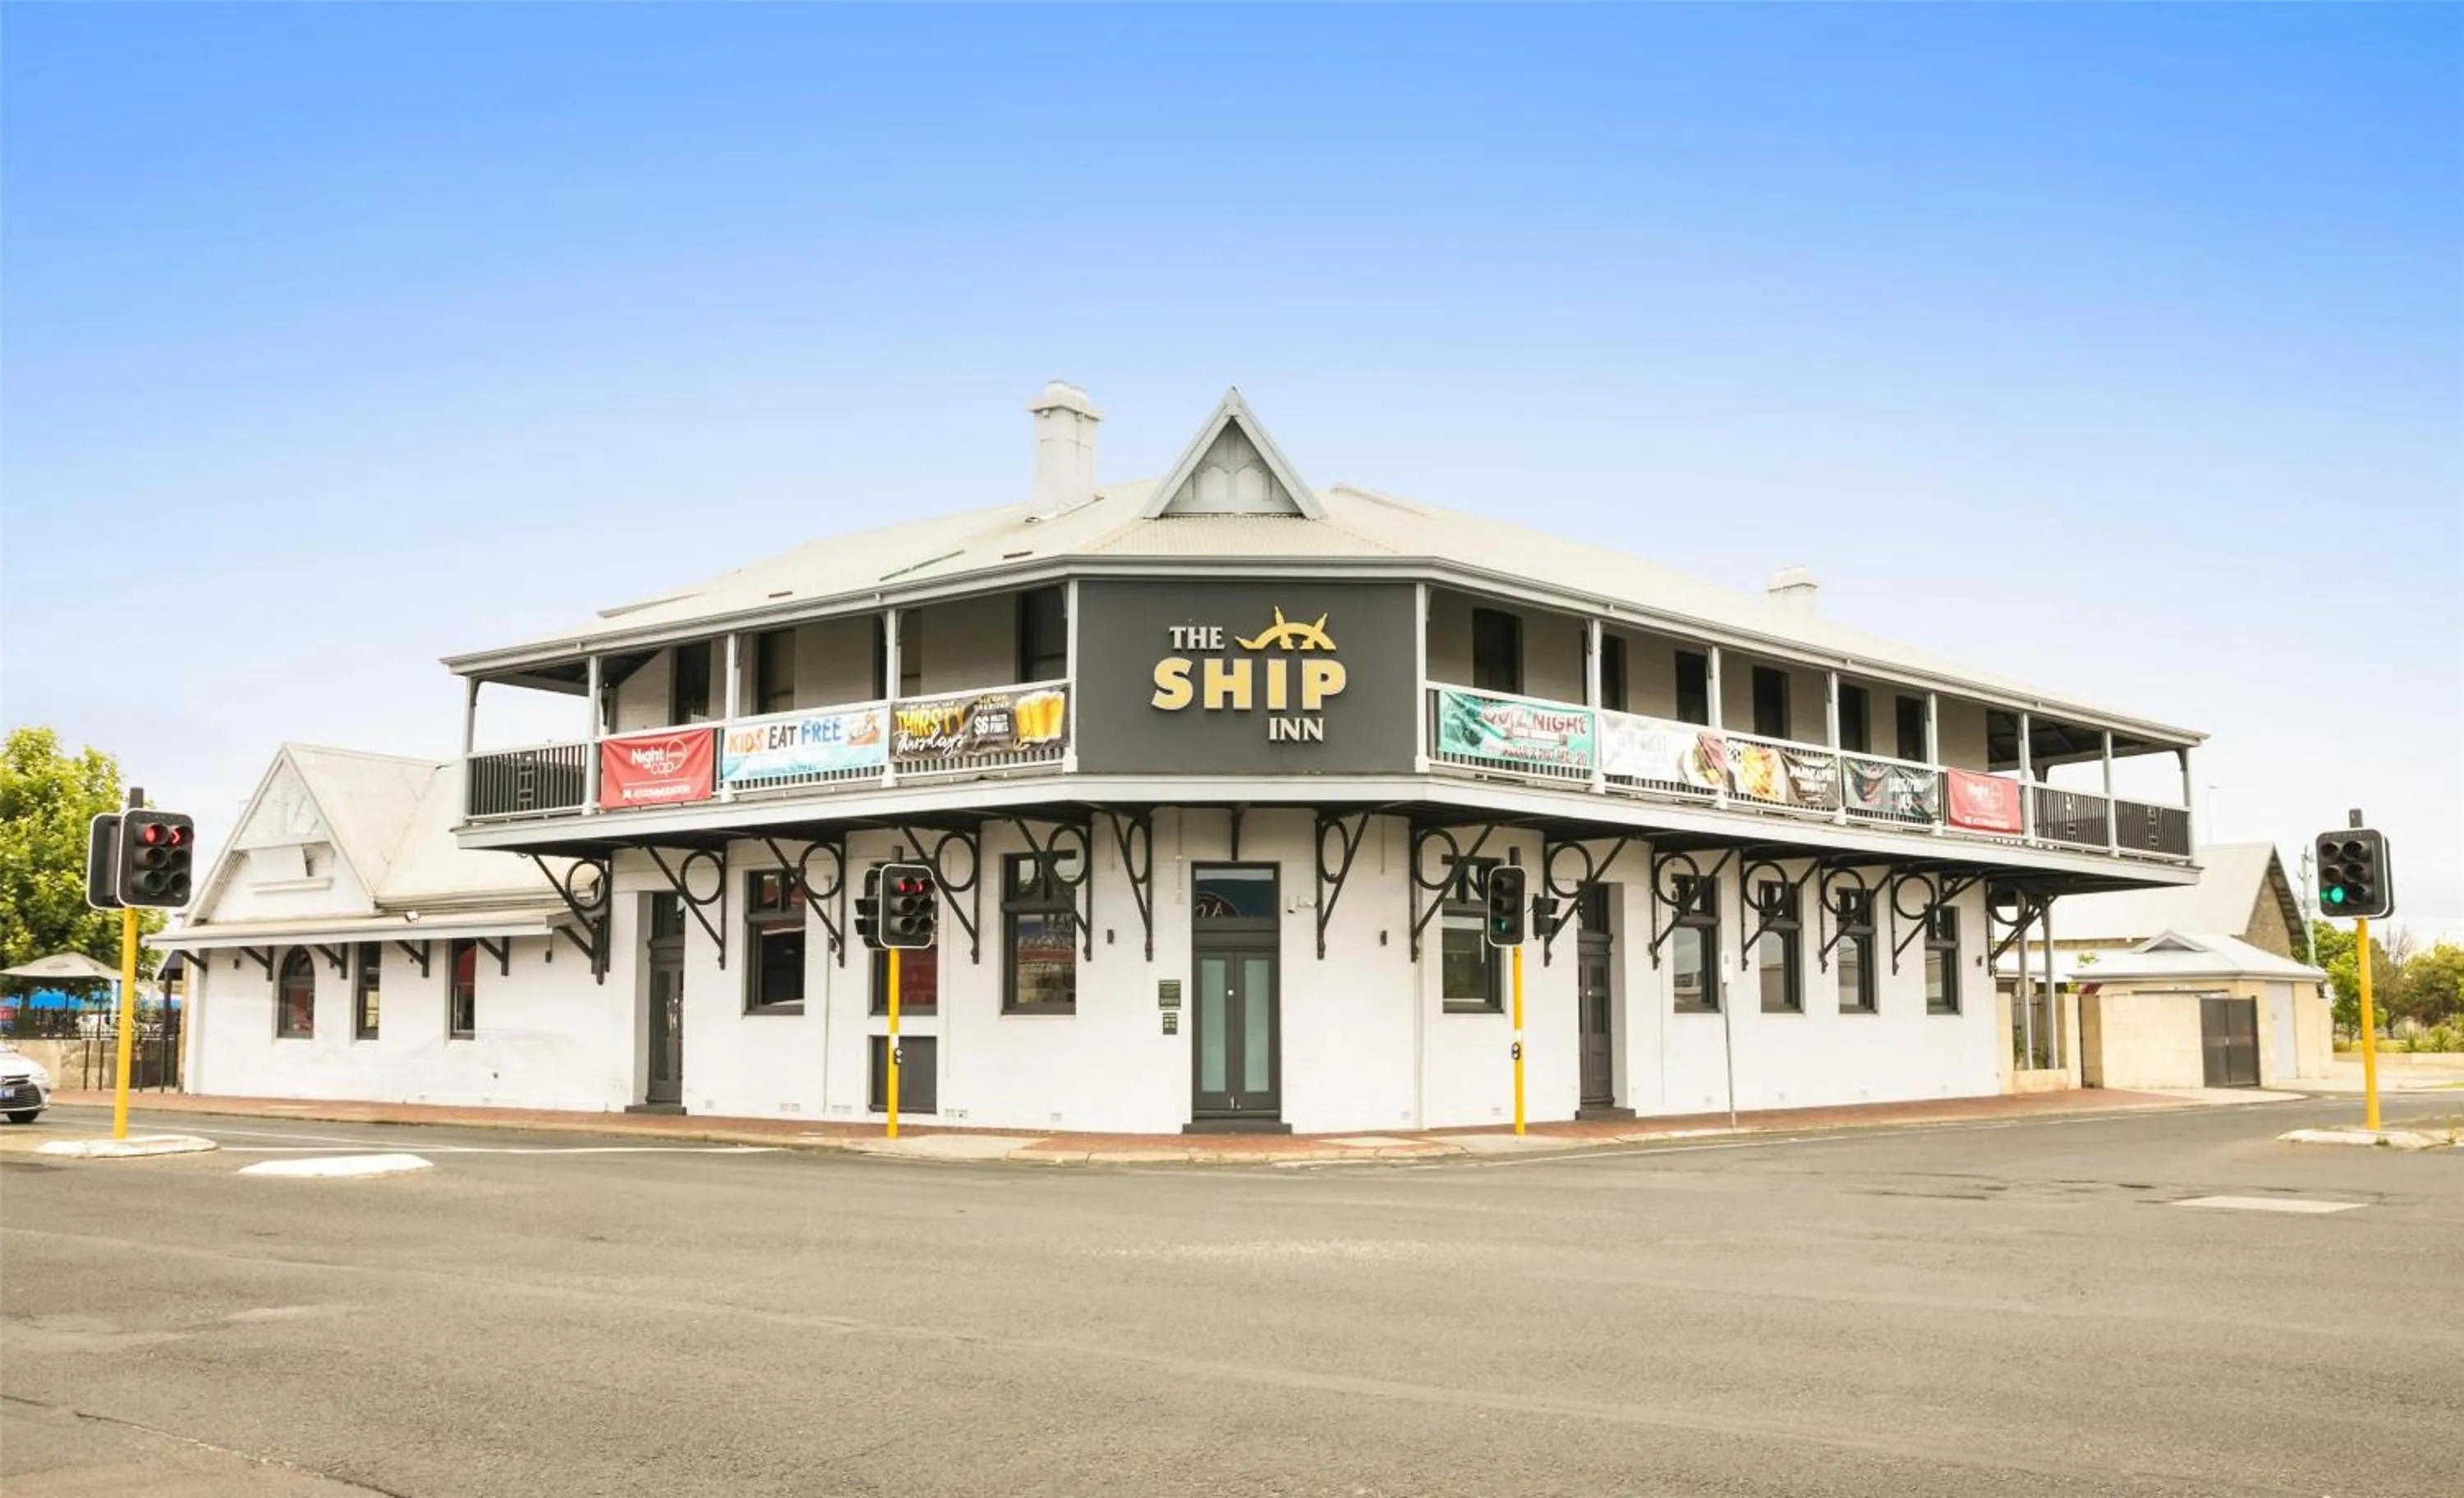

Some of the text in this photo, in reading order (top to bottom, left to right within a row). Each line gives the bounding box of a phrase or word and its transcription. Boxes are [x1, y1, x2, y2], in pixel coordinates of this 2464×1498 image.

[1169, 627, 1225, 650] THE
[1152, 657, 1347, 710] SHIP
[895, 705, 966, 737] THIRSTY
[973, 715, 990, 736] $6
[1269, 717, 1325, 742] INN
[729, 728, 765, 753] KIDS
[768, 724, 798, 750] EAT
[801, 717, 842, 746] FREE
[631, 746, 664, 770] Night
[650, 761, 673, 776] cap
